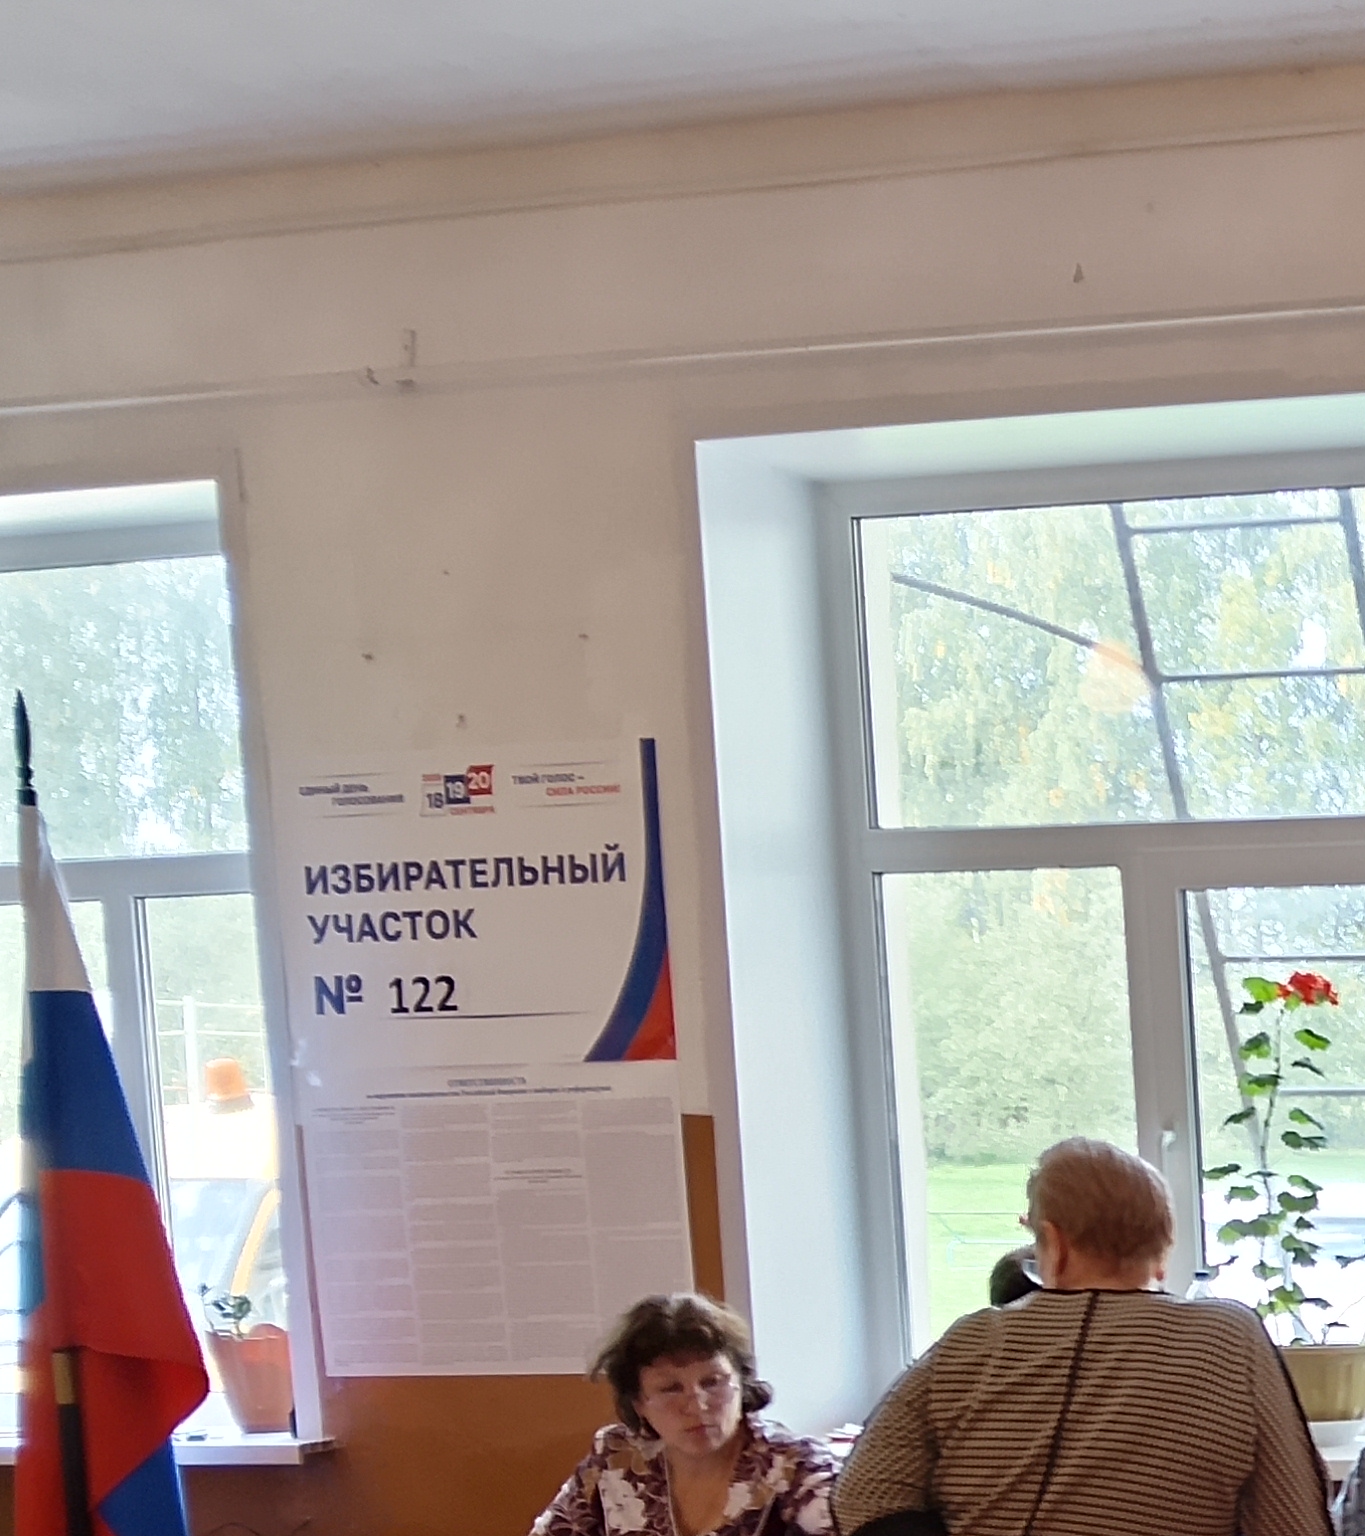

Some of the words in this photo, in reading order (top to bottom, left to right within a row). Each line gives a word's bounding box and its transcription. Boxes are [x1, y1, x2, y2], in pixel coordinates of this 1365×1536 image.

[446, 780, 466, 799] 19
[467, 771, 491, 790] 20
[426, 792, 444, 809] 18
[304, 843, 627, 895] ИЗБИРАТЕЛЬНЫЙ
[307, 909, 478, 944] УЧАСТОК
[388, 975, 459, 1014] 122
